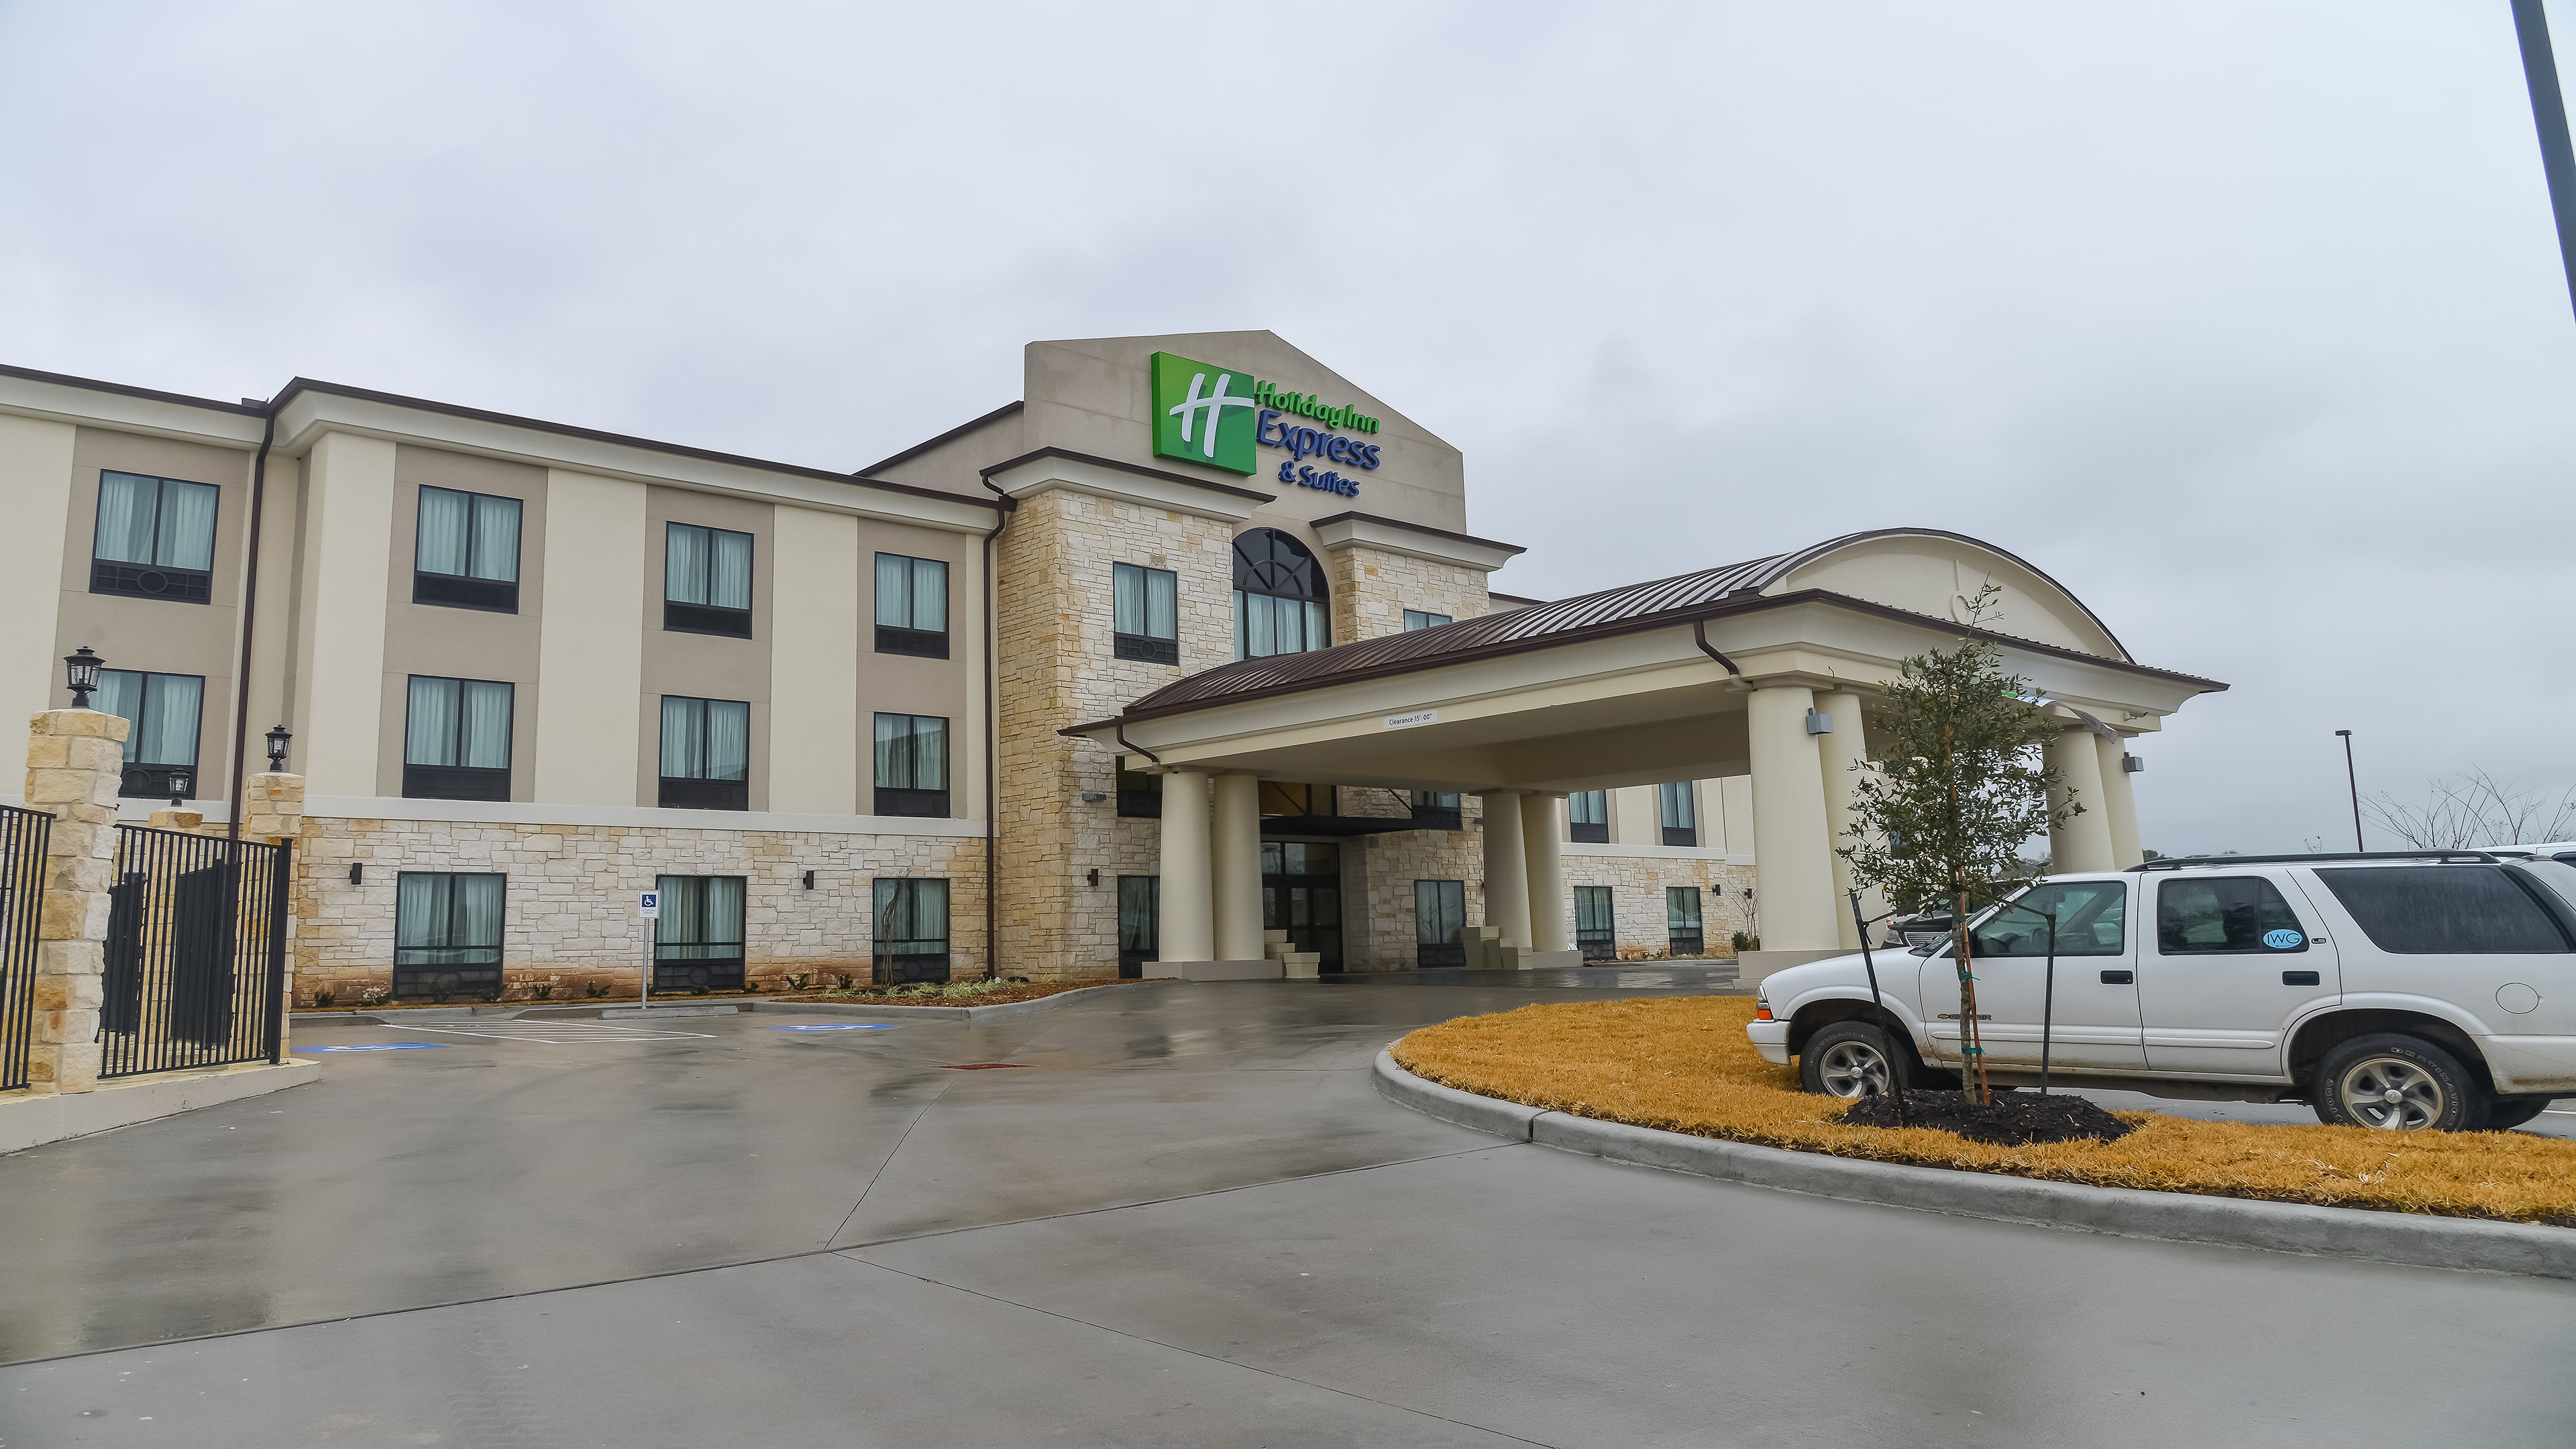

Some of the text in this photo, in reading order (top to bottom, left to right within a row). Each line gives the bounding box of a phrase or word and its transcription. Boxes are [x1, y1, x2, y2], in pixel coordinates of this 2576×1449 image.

[1254, 380, 1380, 435] Holiday Inn
[1256, 409, 1381, 470] Express
[1278, 460, 1360, 497] & Suites
[1389, 716, 1413, 725] Clearance
[2267, 933, 2300, 945] IWG
[2391, 1047, 2458, 1126] DESTINATION
